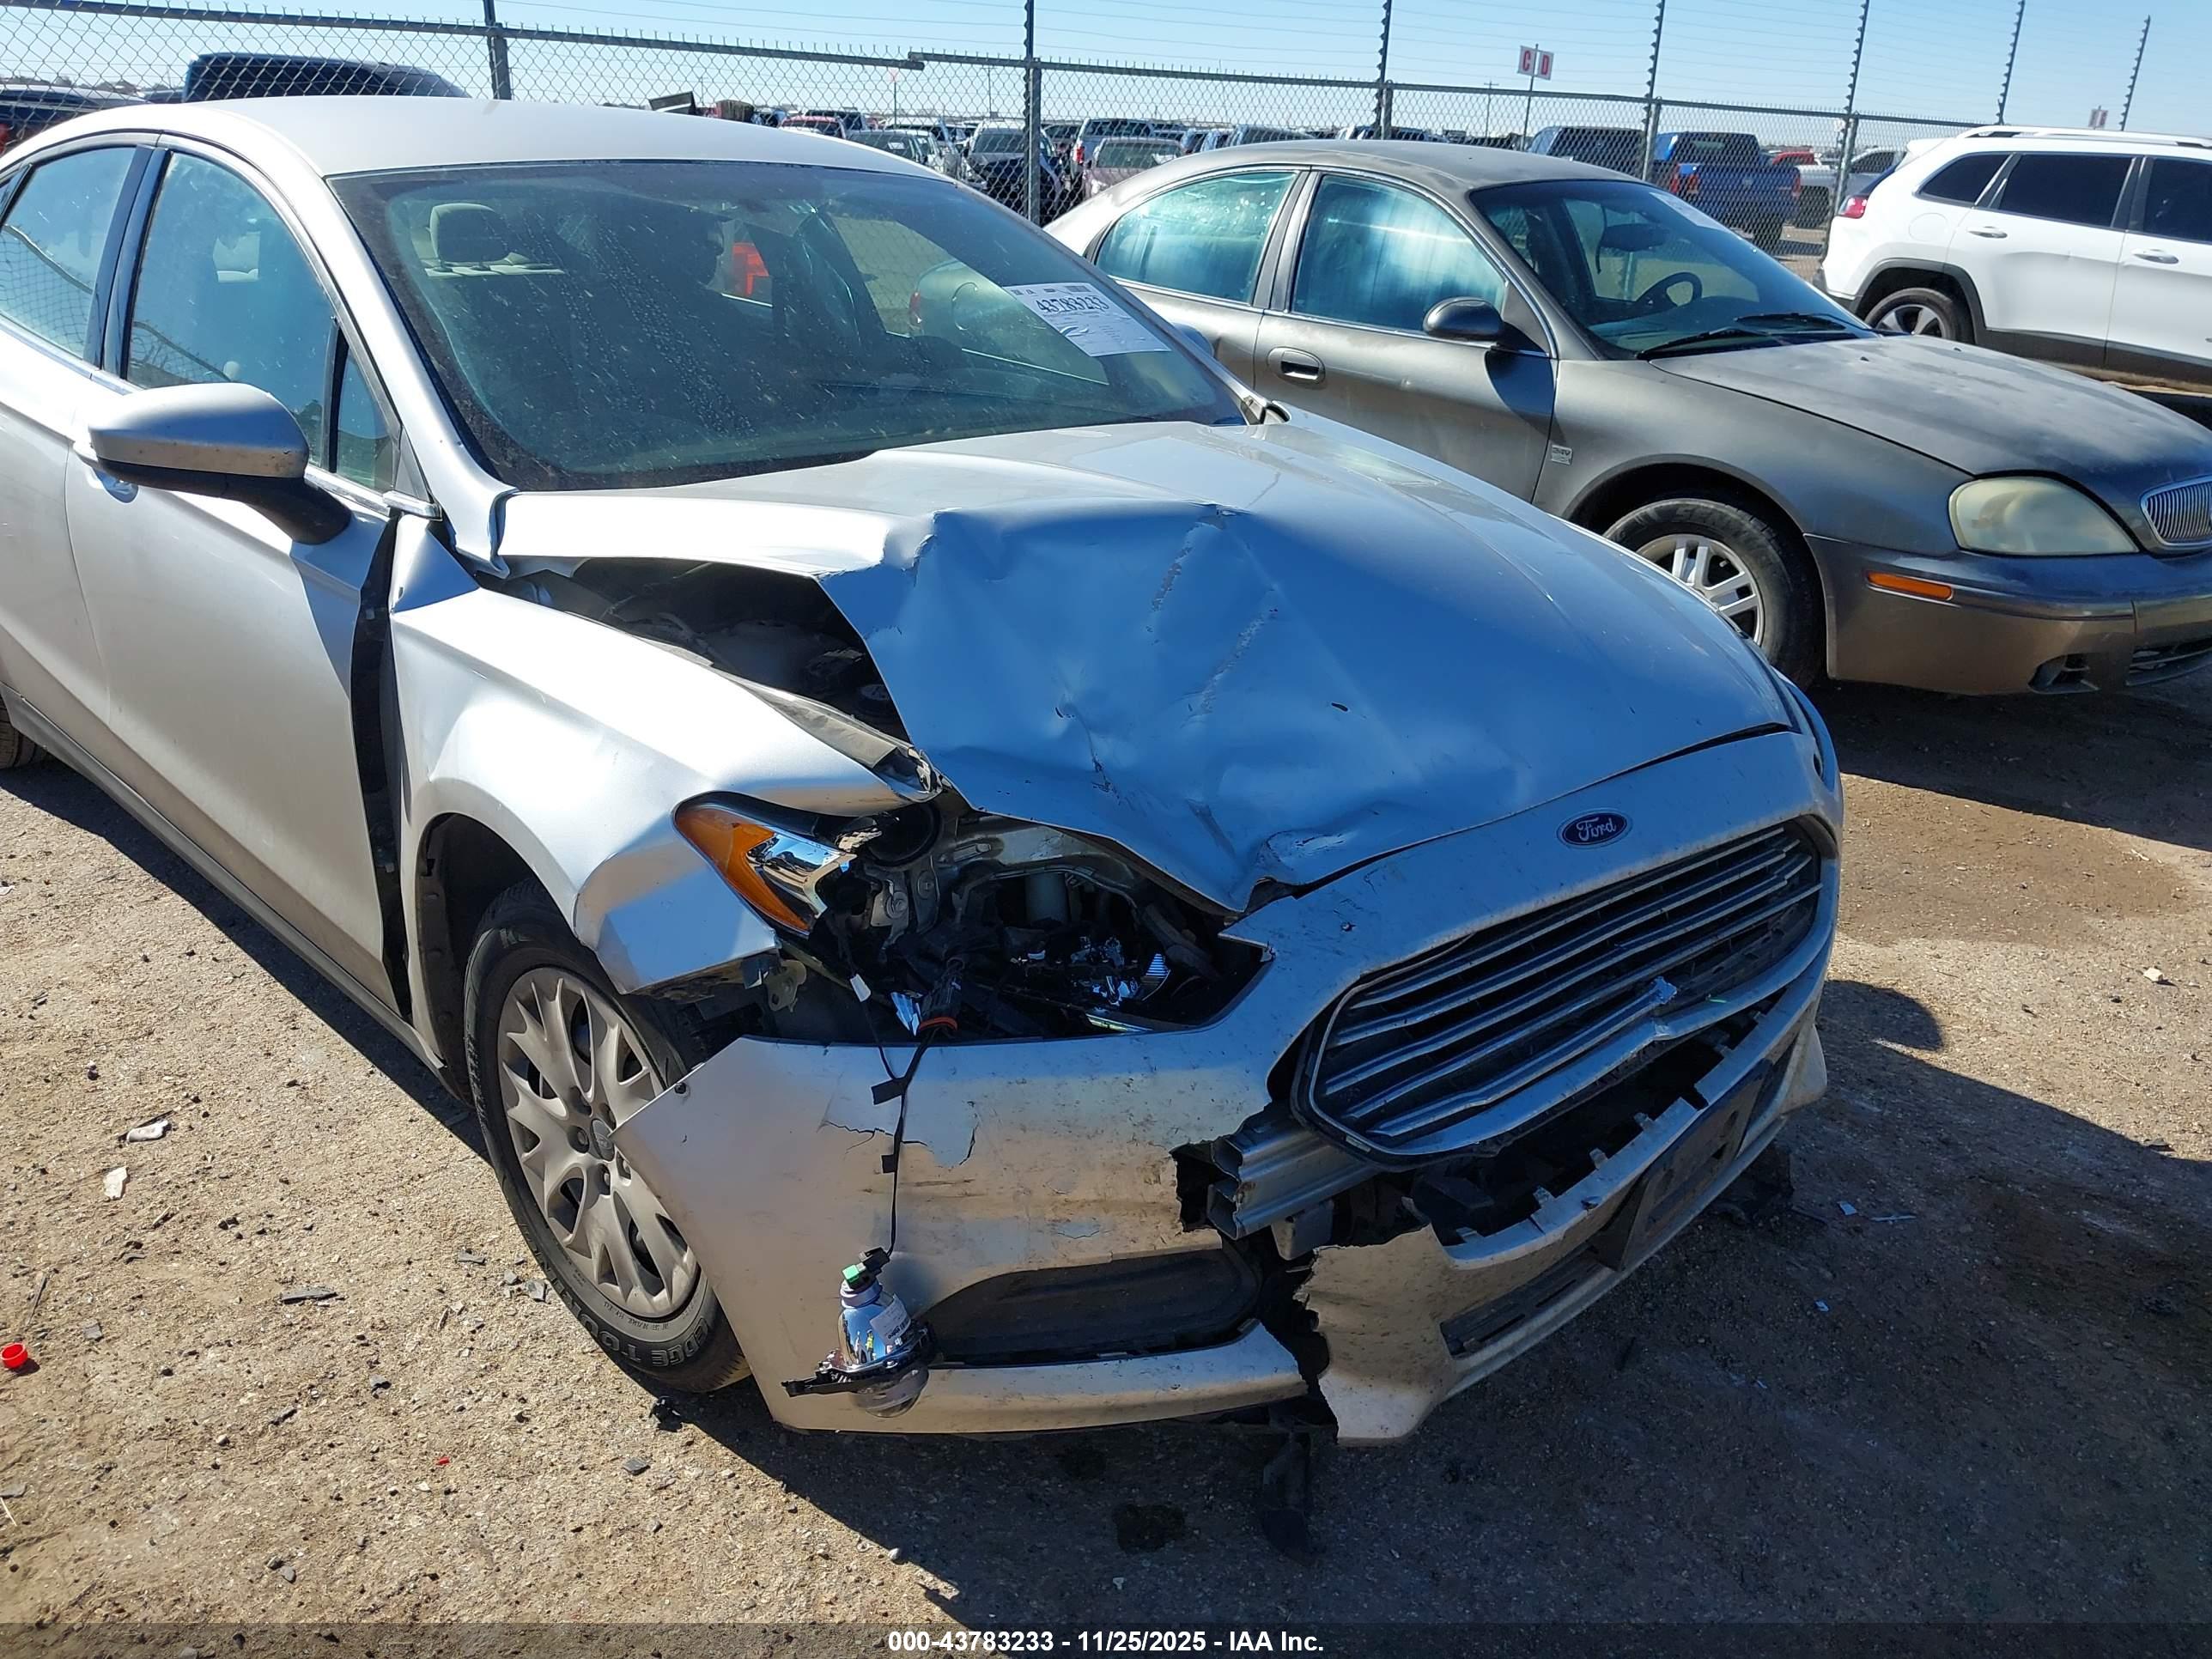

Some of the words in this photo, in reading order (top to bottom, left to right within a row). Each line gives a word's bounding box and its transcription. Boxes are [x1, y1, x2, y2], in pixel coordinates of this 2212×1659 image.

[1522, 50, 1531, 71] C
[1540, 55, 1549, 75] D
[1036, 296, 1109, 313] 43783233
[1576, 817, 1617, 842] Ford
[650, 1316, 708, 1367] EDGE
